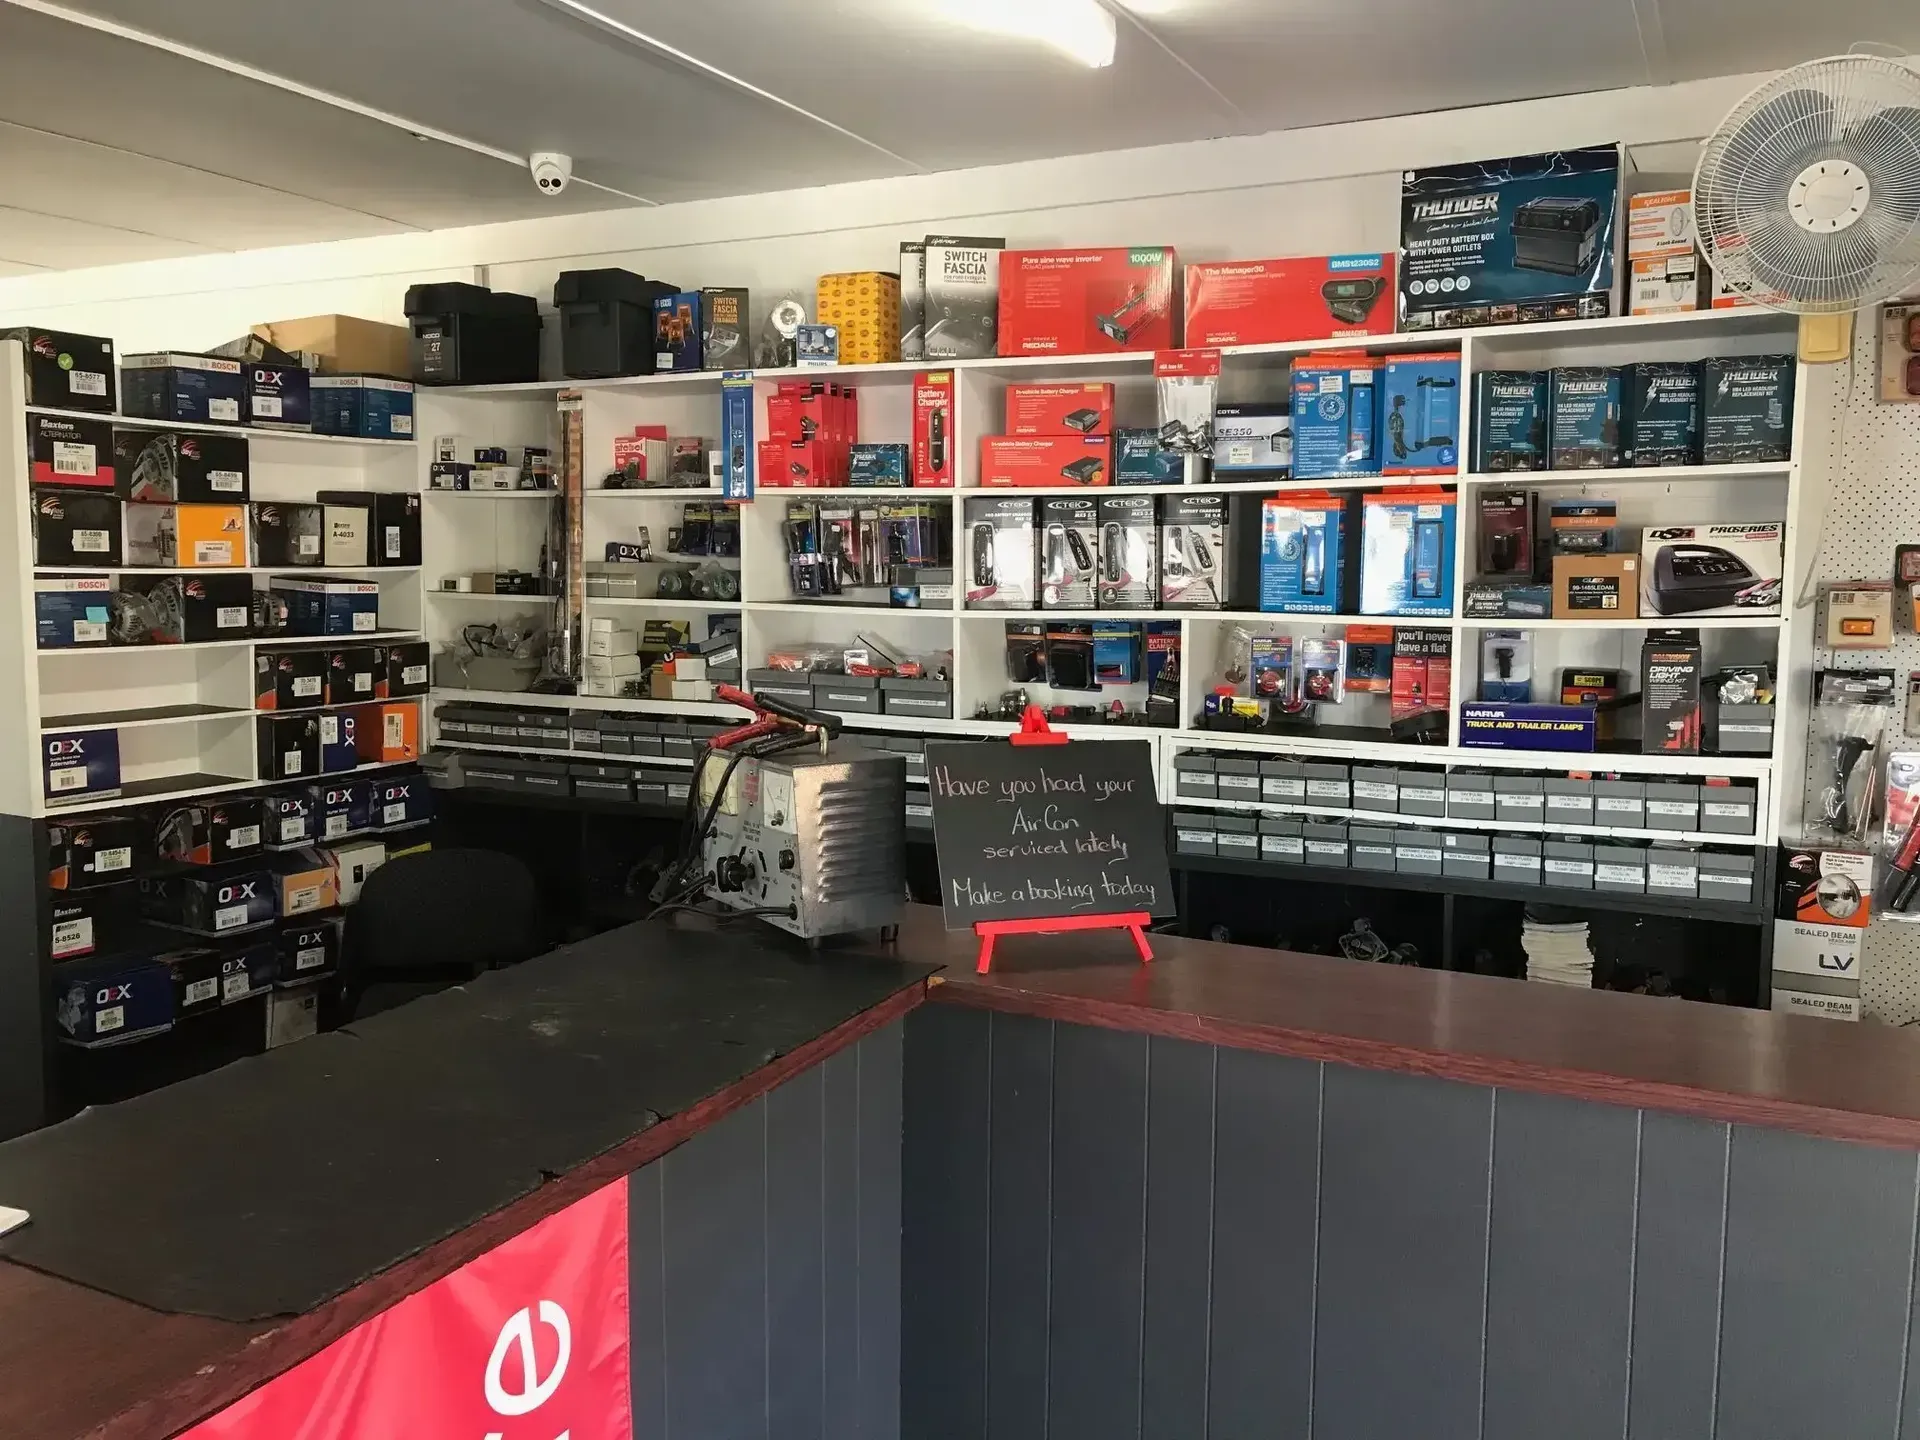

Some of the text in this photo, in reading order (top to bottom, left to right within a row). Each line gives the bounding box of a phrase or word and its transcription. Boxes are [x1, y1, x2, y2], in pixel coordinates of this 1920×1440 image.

[1411, 191, 1500, 222] THUNDER
[1409, 240, 1431, 249] HEAVY
[1451, 235, 1479, 244] BATTERY
[1480, 233, 1495, 241] BOX
[1409, 243, 1482, 257] WITH POWER OUTLETS
[943, 250, 988, 263] SWITCH
[1022, 256, 1038, 265] Pure
[1075, 255, 1103, 264] inverter
[1129, 253, 1163, 264] 1000W
[943, 262, 987, 275] FASCIA
[1205, 265, 1265, 275] The Manager30
[713, 297, 738, 305] SWITCH
[713, 305, 738, 314] FASCIA
[430, 342, 441, 351] 27
[211, 361, 238, 372] BOSCH
[254, 369, 283, 387] OEX
[1722, 370, 1779, 382] THUNDER
[339, 379, 359, 387] BOSCH
[393, 382, 412, 391] BOSCH
[1557, 381, 1609, 394] THUNDER
[917, 390, 946, 400] Battery
[1059, 388, 1080, 396] Charger
[1491, 385, 1535, 398] THUNDER
[917, 397, 949, 407] Charger
[40, 418, 75, 430] Baxters
[40, 430, 82, 440] ALTERNATOR
[1217, 428, 1253, 437] SE350
[332, 531, 355, 539] A-4033
[1709, 524, 1778, 534] PROSERIES
[77, 581, 107, 590] BOSCH
[1148, 637, 1176, 646] BATTERY
[1397, 630, 1453, 642] you'll never
[1397, 641, 1447, 653] have a flat
[1648, 665, 1695, 673] DRIVING
[1465, 710, 1505, 718] NARVA
[1465, 720, 1584, 731] TRUCK AND TRAILER LAMPS
[344, 717, 356, 747] OEX
[49, 738, 85, 755] OEX
[50, 759, 78, 768] Alternator
[935, 765, 1136, 803] Have you had your
[326, 788, 353, 805] OEX
[385, 786, 410, 800] OEX
[281, 799, 303, 813] OEX
[983, 830, 1130, 865] serviced lately
[218, 881, 257, 904] OEX
[952, 871, 1157, 910] Make a booking today
[54, 907, 83, 918] Baxters
[1794, 927, 1857, 940] SEALED BEAM
[1818, 954, 1854, 971] LV
[96, 983, 133, 1004] OEX
[1790, 996, 1853, 1011] SEALED BEAM
